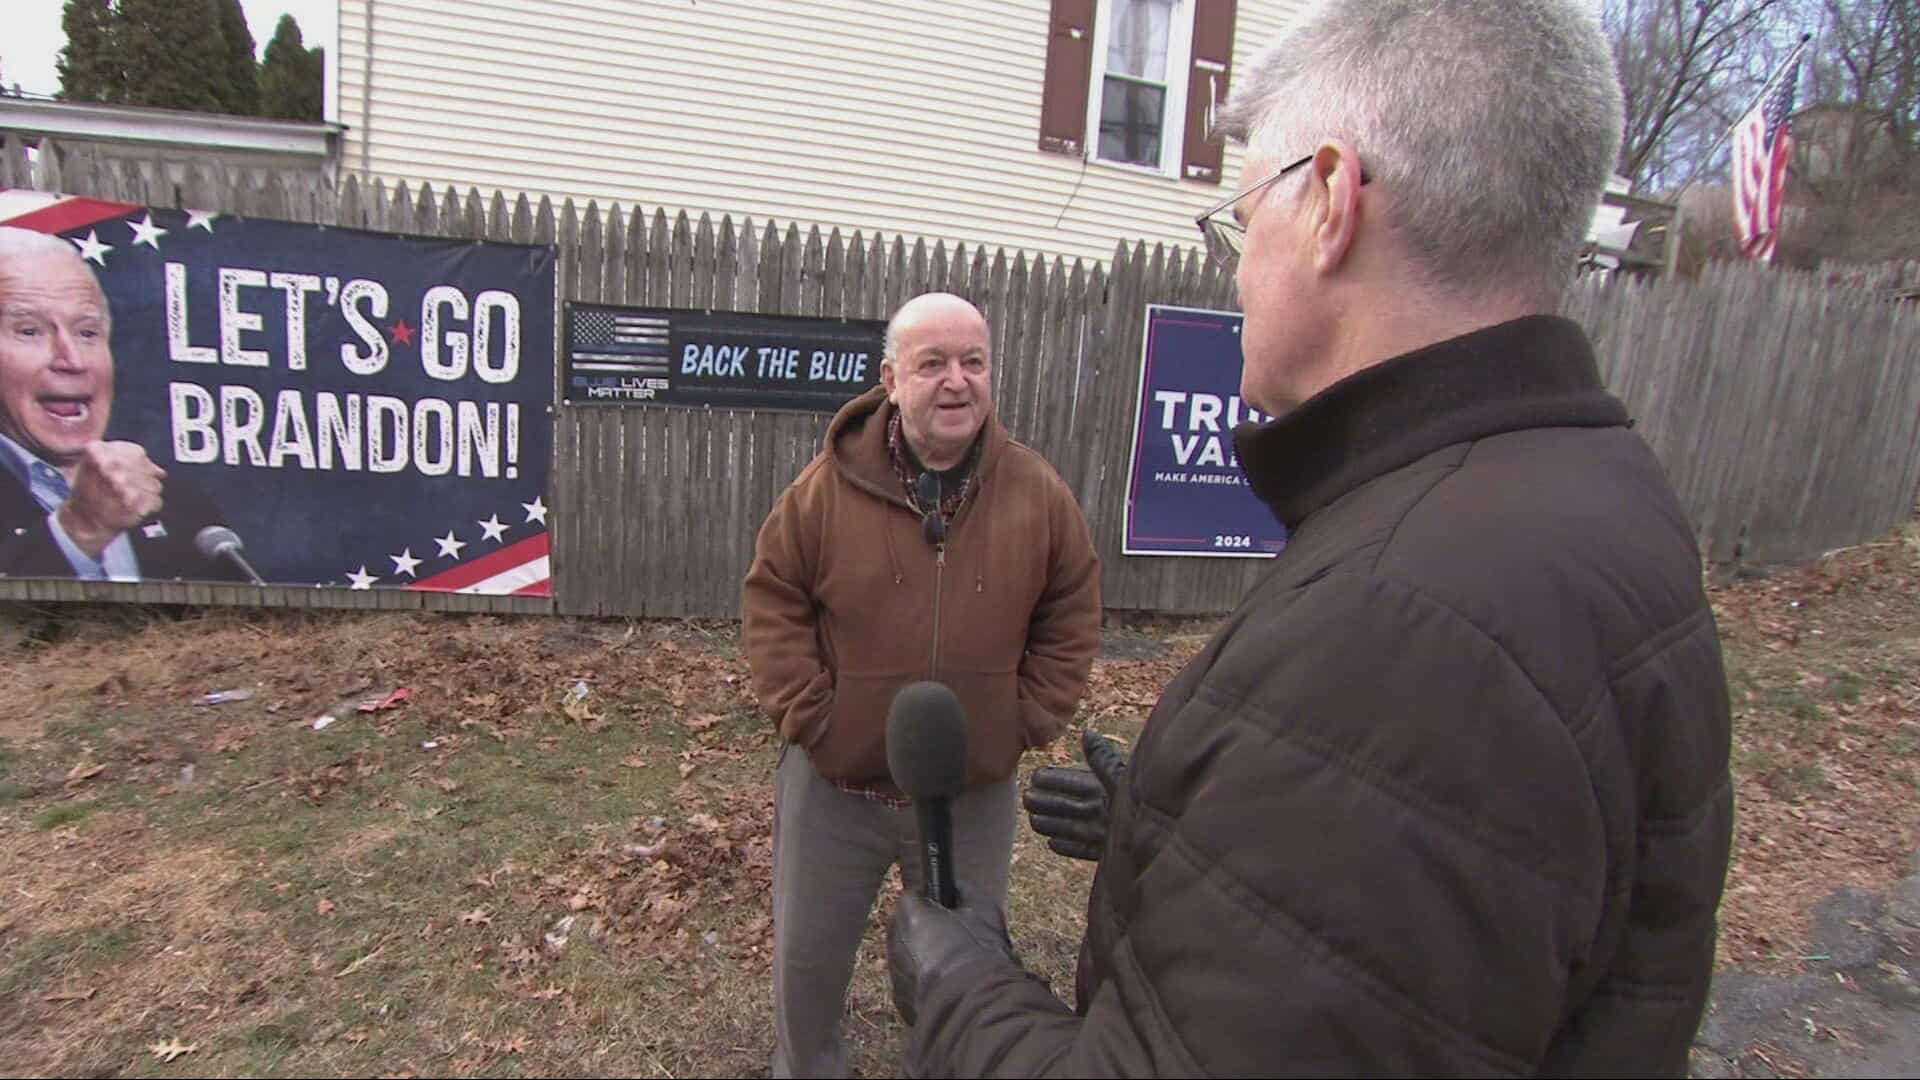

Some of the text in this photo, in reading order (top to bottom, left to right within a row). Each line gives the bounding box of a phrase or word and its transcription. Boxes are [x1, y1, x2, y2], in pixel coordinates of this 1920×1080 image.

[164, 262, 521, 384] LET'S GO
[681, 343, 868, 382] BACK THE BLUE
[587, 386, 656, 399] MATTER
[621, 377, 669, 389] LIVES
[1154, 390, 1276, 433] TRU
[168, 381, 520, 479] BRANDON!
[1171, 433, 1240, 467] VA
[1154, 471, 1188, 482] MAKE
[1189, 473, 1241, 485] AMERICA
[1214, 535, 1251, 548] 2024
